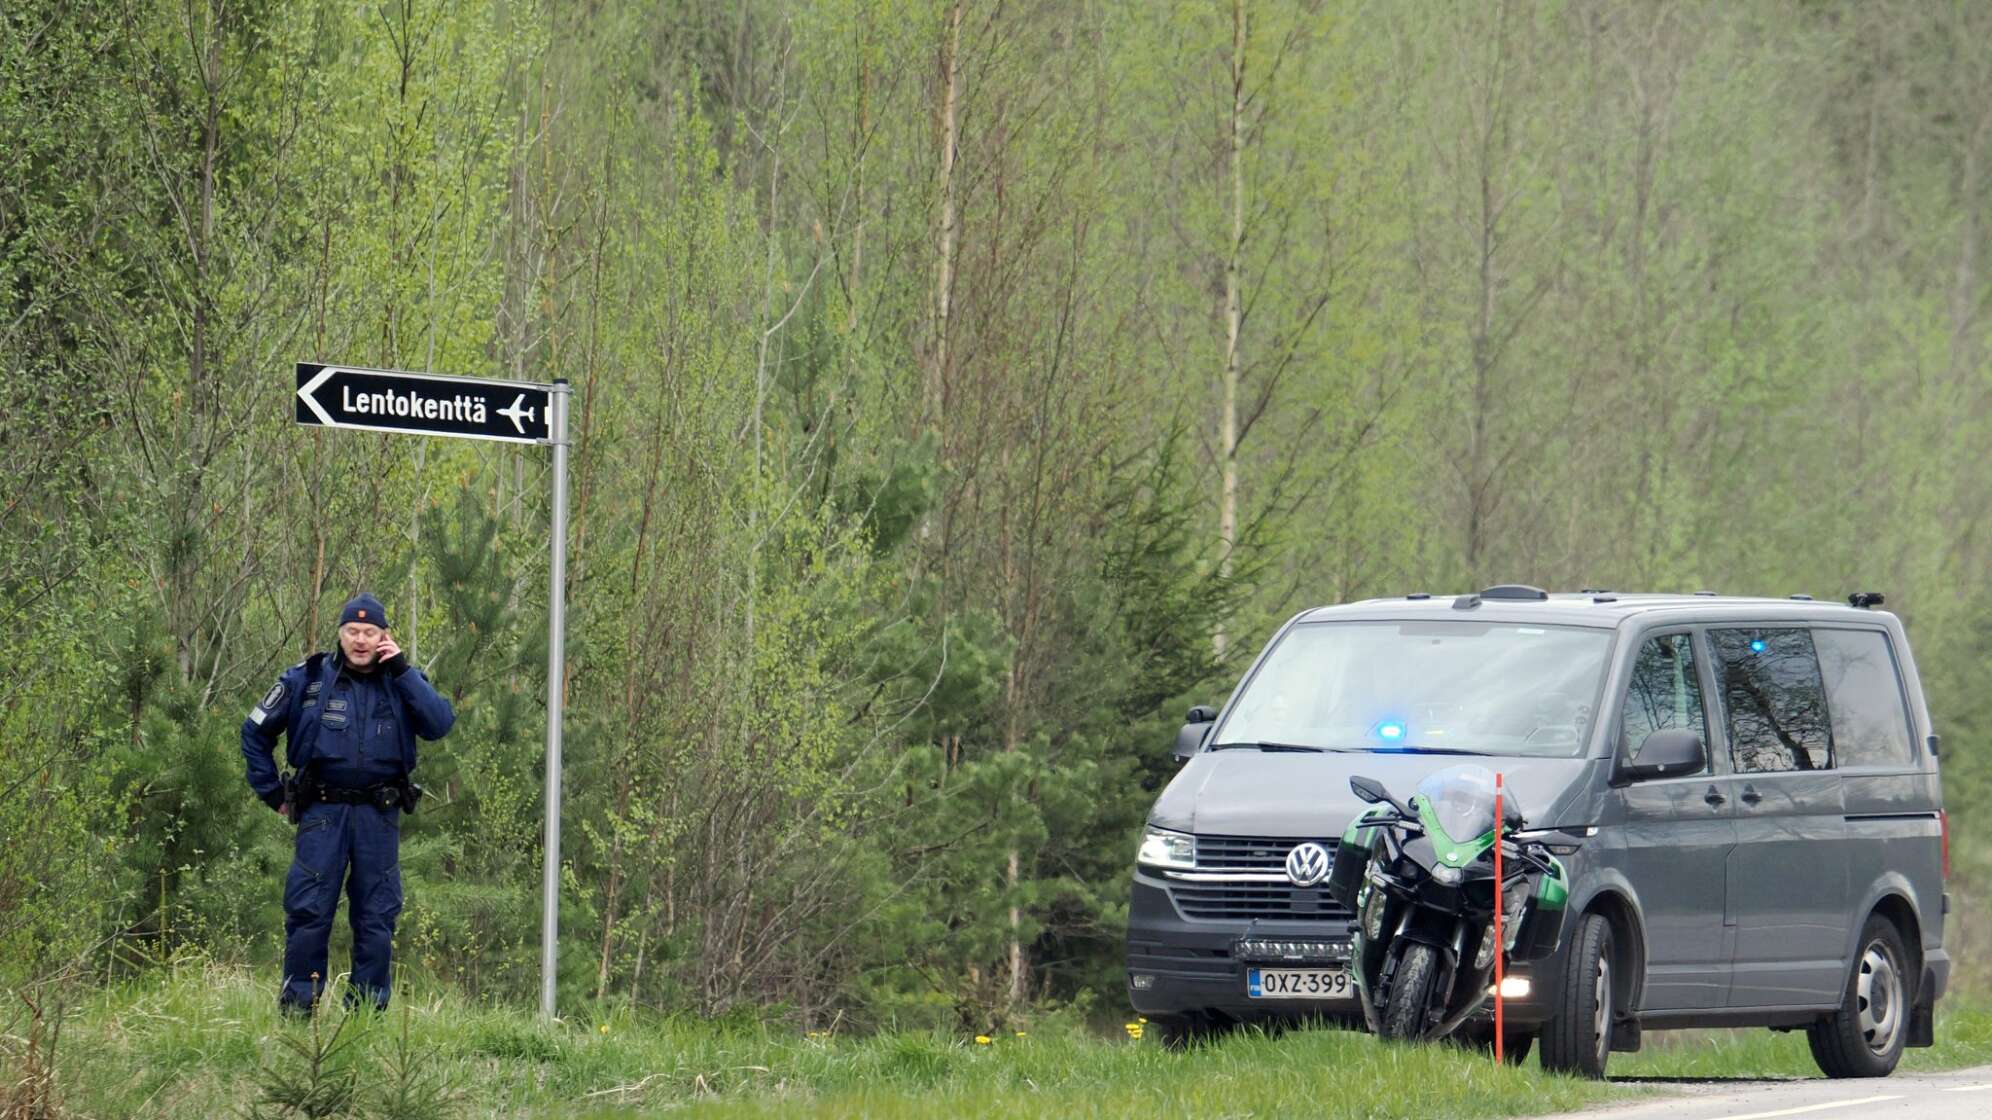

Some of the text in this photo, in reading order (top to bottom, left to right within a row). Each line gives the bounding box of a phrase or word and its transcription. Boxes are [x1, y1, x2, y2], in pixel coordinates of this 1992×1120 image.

[343, 385, 486, 423] Lentokenttä
[1287, 843, 1328, 886] VW
[1264, 973, 1346, 993] OXZ-399
